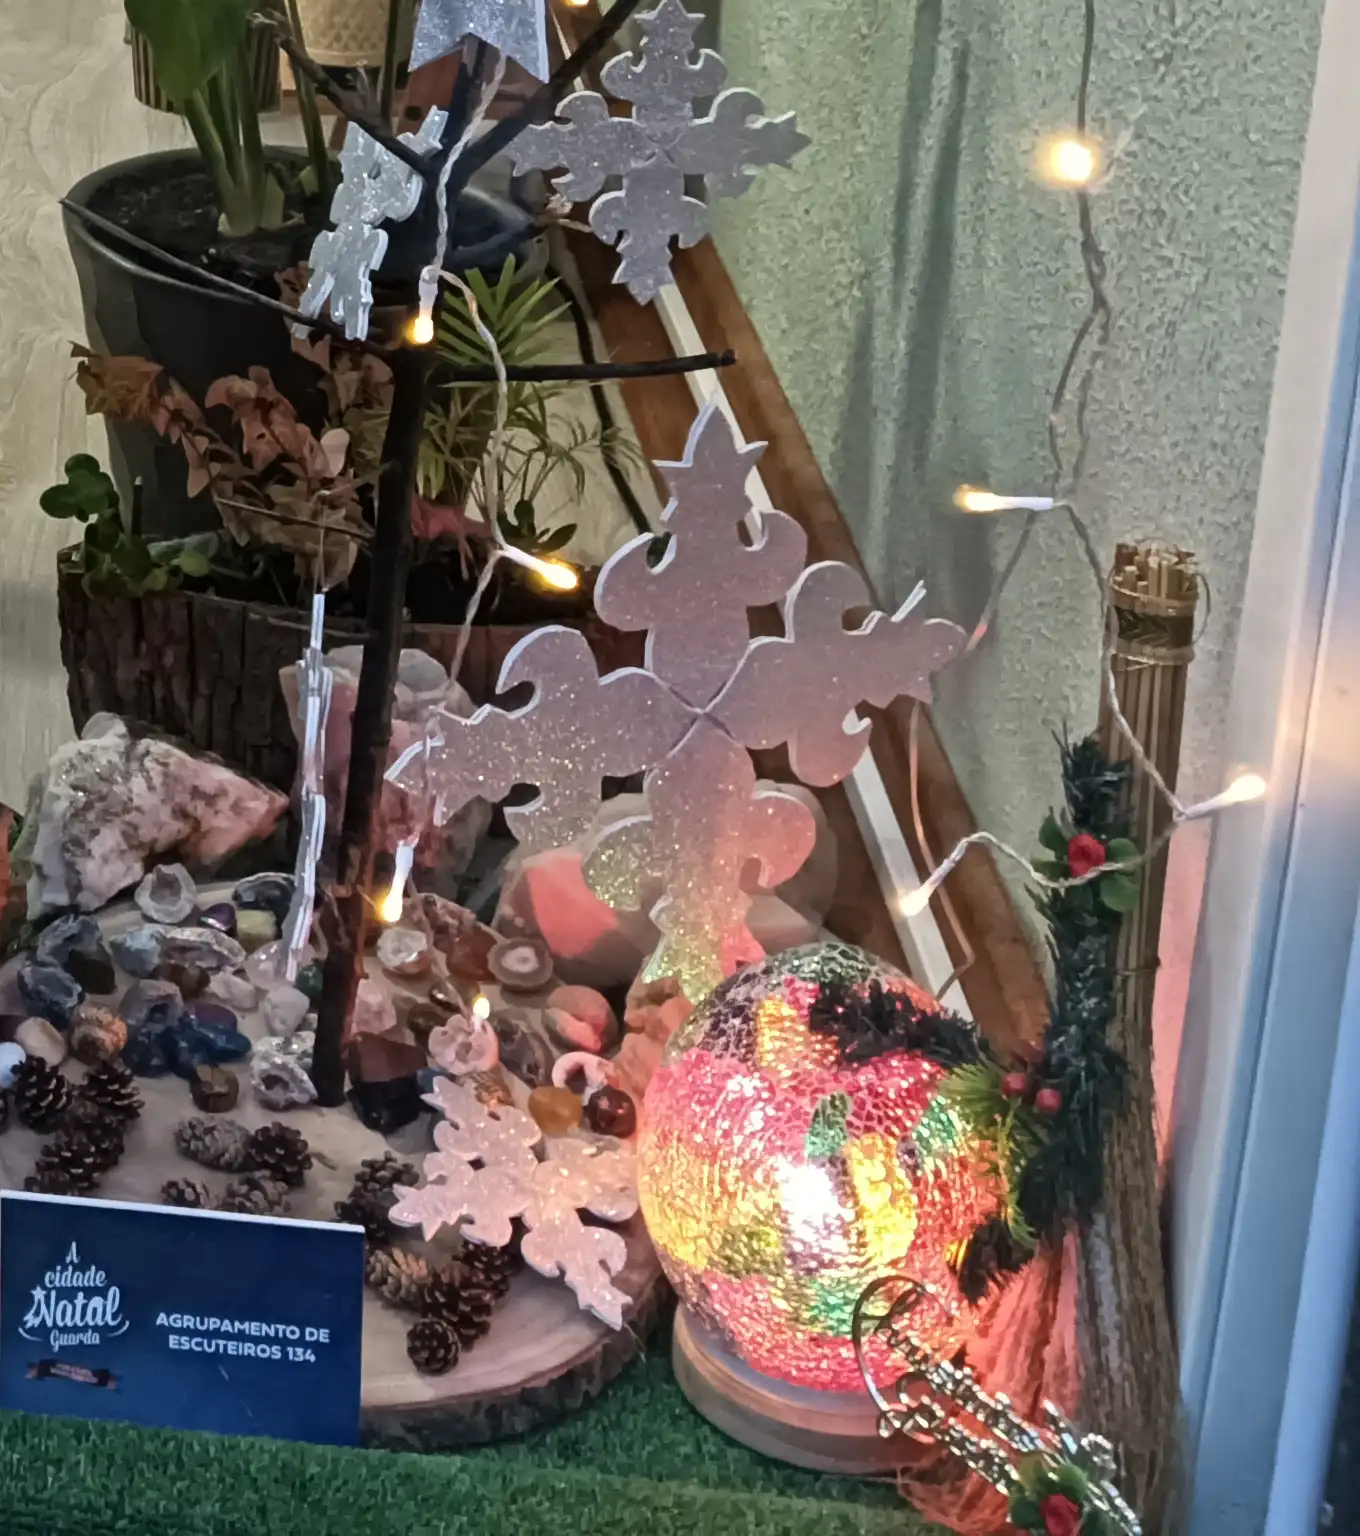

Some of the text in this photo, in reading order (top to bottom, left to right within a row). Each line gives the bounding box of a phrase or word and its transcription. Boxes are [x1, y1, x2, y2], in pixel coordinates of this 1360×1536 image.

[65, 1241, 80, 1264] A
[44, 1264, 108, 1289] cidade
[23, 1285, 123, 1329] Natal
[49, 1328, 101, 1353] Guarda
[155, 1311, 331, 1344] AGRUPAMENTO DE
[167, 1333, 317, 1364] ESCUTEIROS 134
